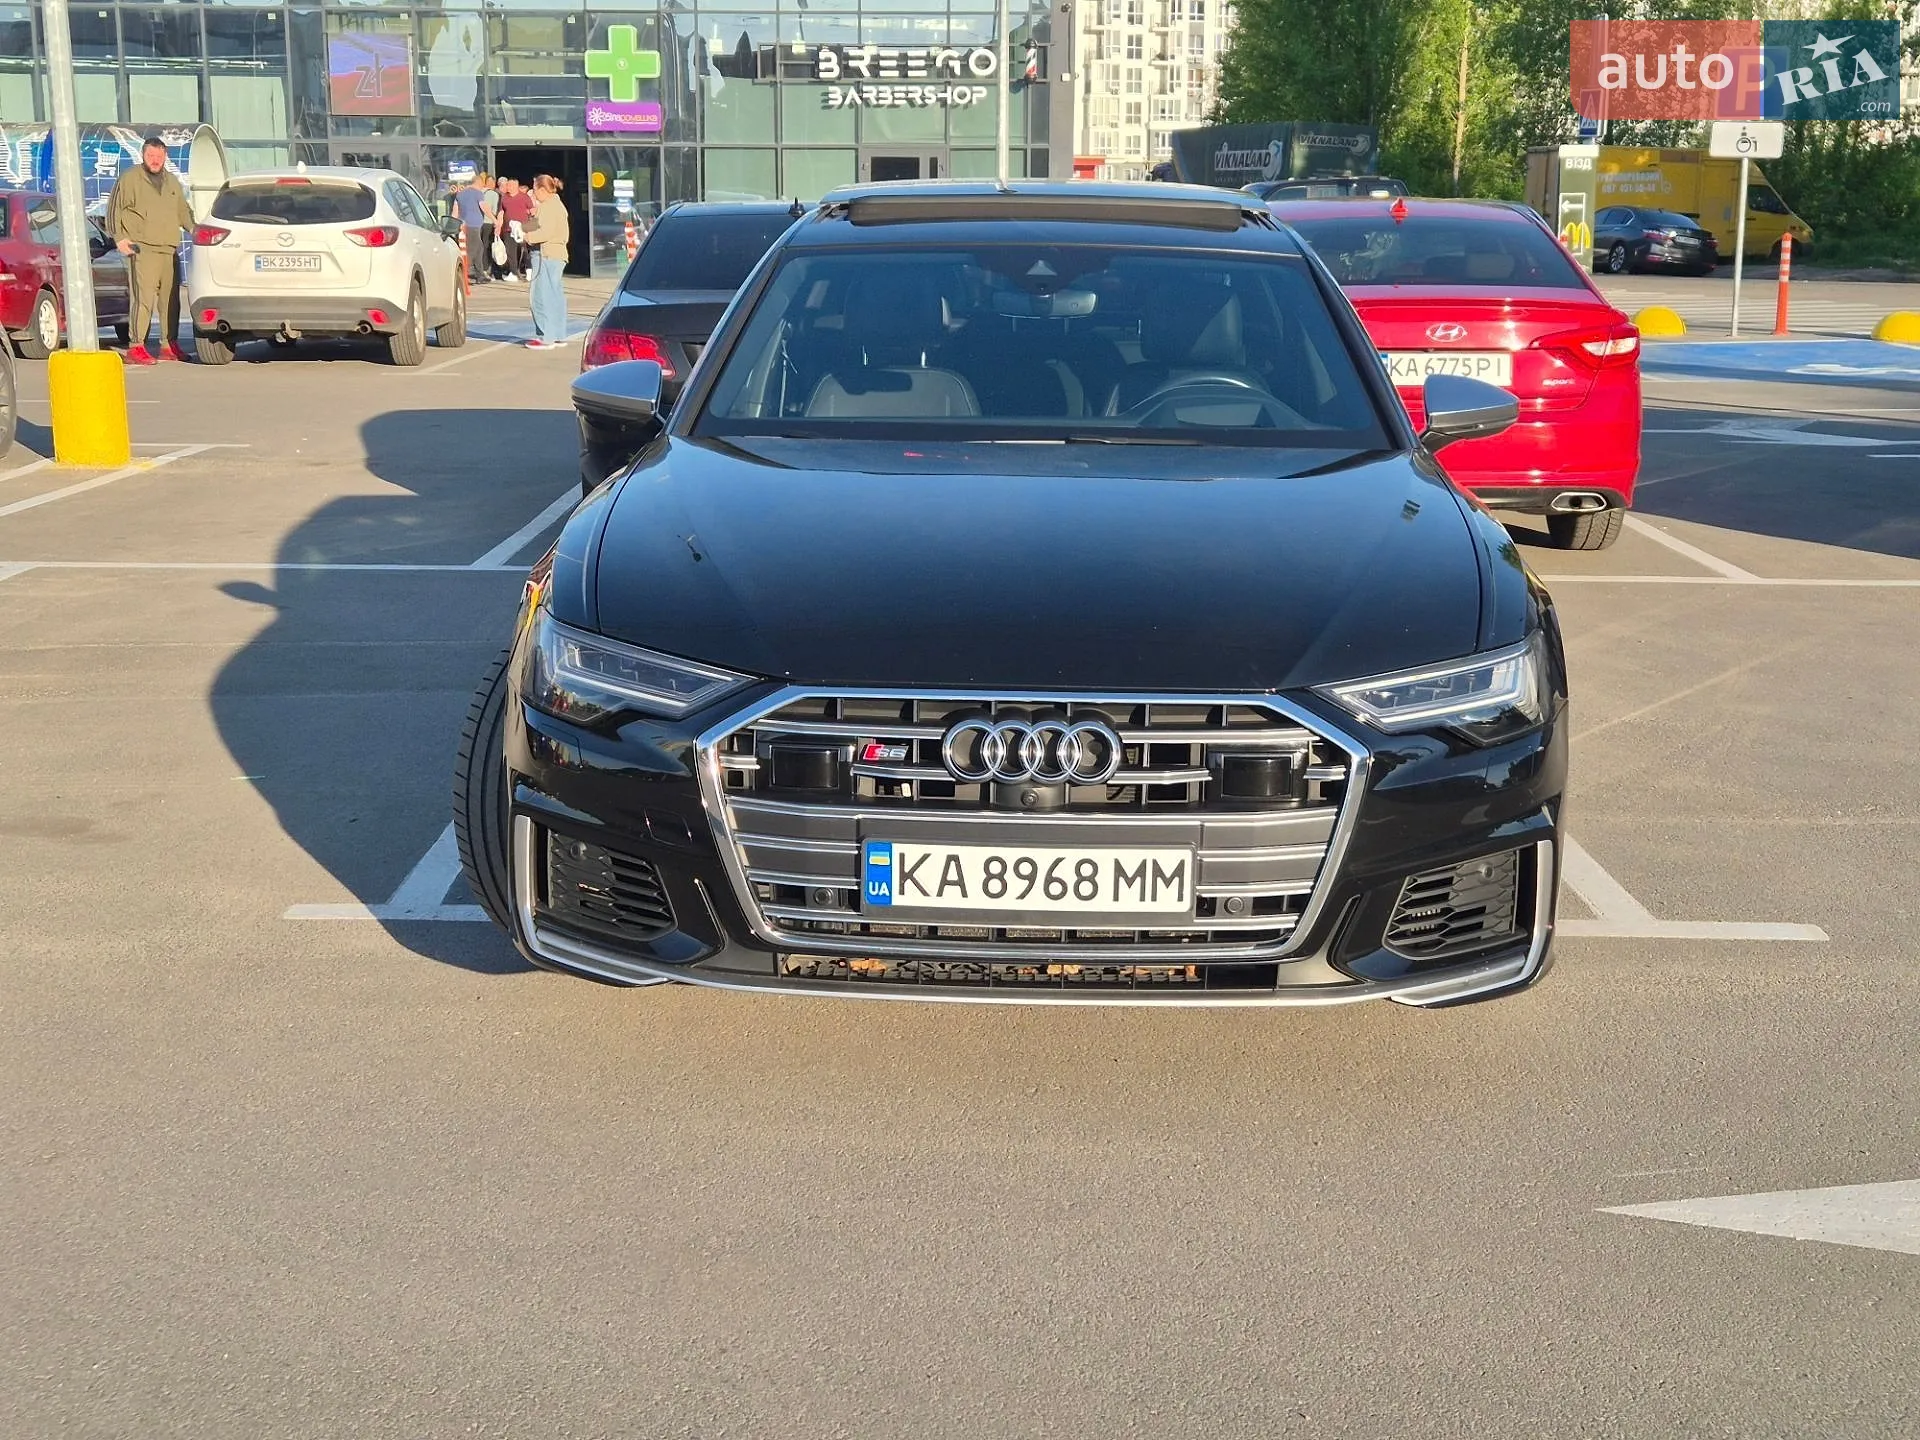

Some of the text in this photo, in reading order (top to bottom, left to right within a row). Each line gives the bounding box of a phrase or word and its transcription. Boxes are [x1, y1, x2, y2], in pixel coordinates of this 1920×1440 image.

[828, 86, 988, 105] BARBERSHOP
[1301, 133, 1360, 148] VIKNALAND
[1215, 150, 1271, 169] VIKNALAND
[262, 257, 277, 267] BK
[304, 257, 318, 267] HT
[1390, 358, 1500, 376] KA 6775 PI
[868, 853, 1186, 902] UA KA 8968 MM
